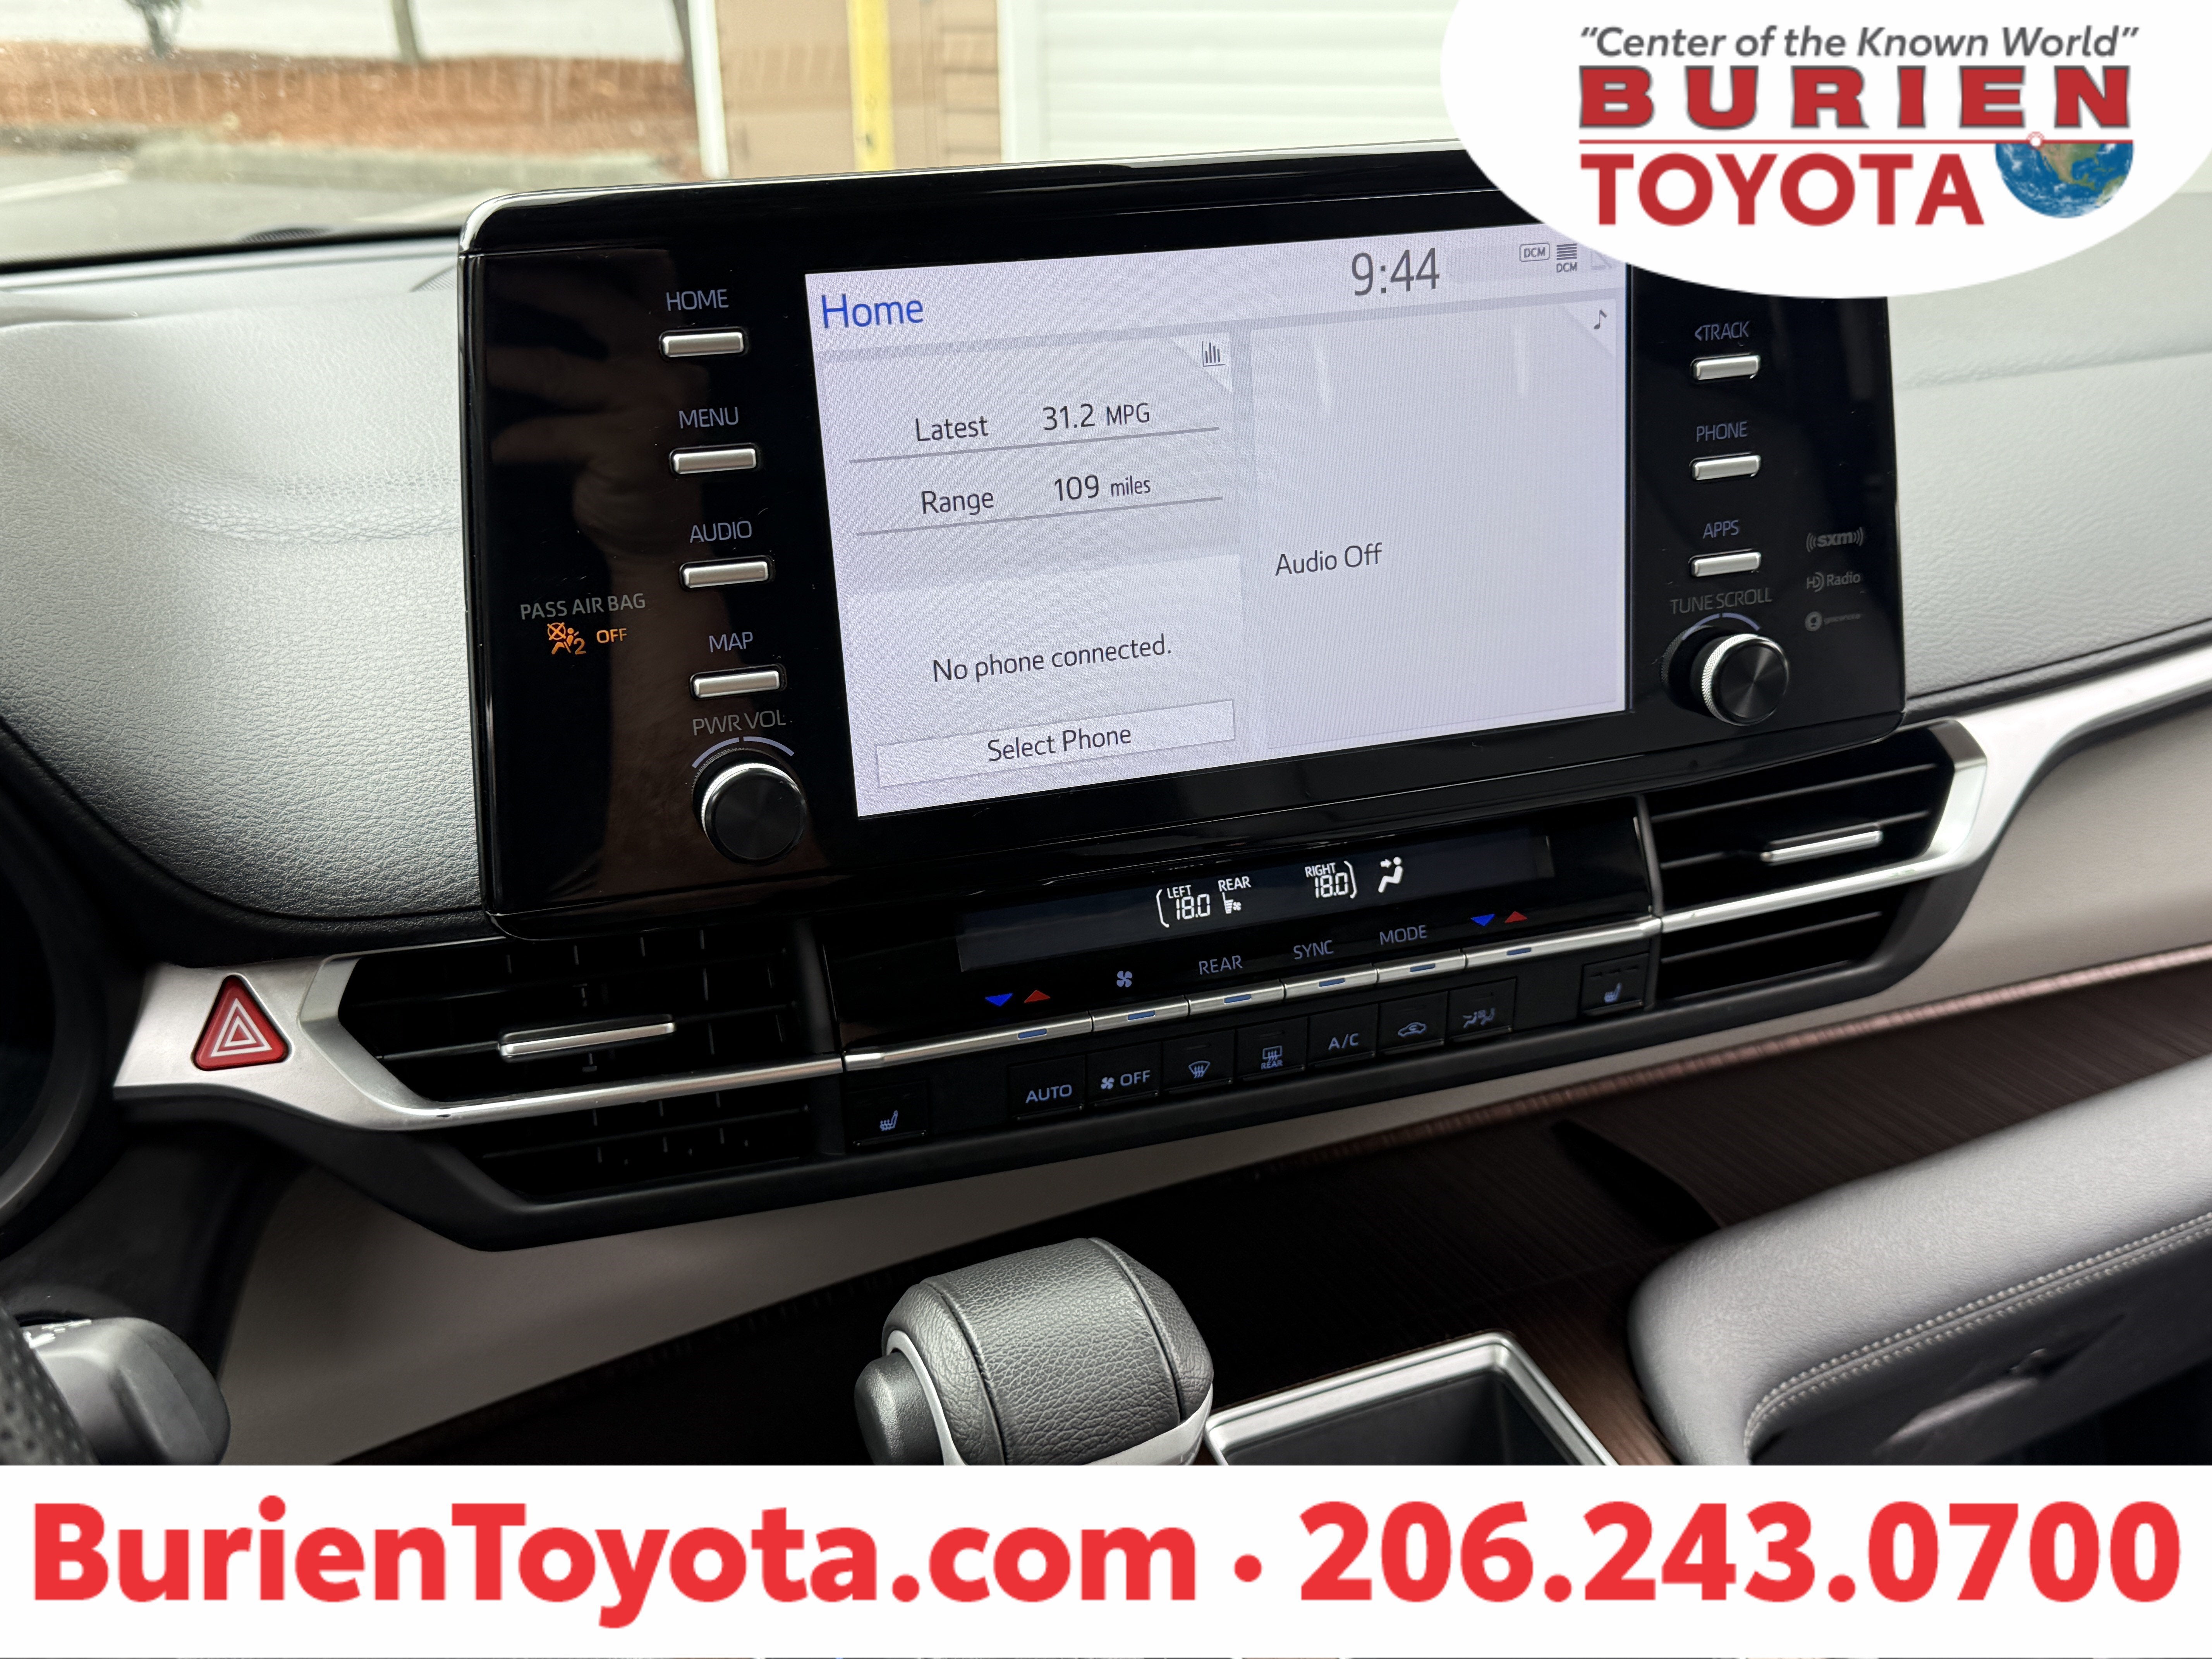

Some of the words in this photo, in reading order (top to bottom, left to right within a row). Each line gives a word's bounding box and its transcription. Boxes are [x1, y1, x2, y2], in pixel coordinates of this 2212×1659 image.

[1523, 247, 1546, 258] DCM
[1352, 247, 1440, 296] 9:44
[1556, 262, 1578, 273] DCM
[666, 289, 729, 311] HOME
[822, 294, 924, 328] Home
[679, 407, 739, 429] MENU
[915, 416, 989, 441] Latest
[1042, 403, 1095, 431] 31.2
[1106, 402, 1151, 426] MPG
[1696, 421, 1748, 442] PHONE
[921, 490, 994, 515] Range
[1054, 474, 1100, 501] 109
[1110, 476, 1151, 496] miles
[690, 520, 752, 543] AUDIO
[1703, 520, 1739, 539] APPS
[1275, 550, 1337, 576] Audio
[1345, 542, 1382, 567] Off
[1827, 571, 1860, 587] Radio
[520, 600, 568, 620] PASS
[572, 597, 605, 615] AIR
[608, 593, 646, 611] BAG
[1670, 596, 1712, 614] TUNE
[1716, 587, 1772, 609] SCROLL
[596, 628, 627, 643] OFF
[709, 632, 754, 653] MAP
[933, 659, 968, 682] No
[975, 652, 1044, 683] phone
[1052, 633, 1172, 668] connected.
[692, 714, 742, 736] PWR
[744, 709, 786, 730] VOL
[988, 734, 1055, 762] Select
[1062, 726, 1132, 752] Phone
[1304, 862, 1336, 878] RIGHT
[1167, 884, 1192, 899] LEFT
[1218, 876, 1251, 892] REAR
[1315, 872, 1349, 898] 18.0
[1176, 893, 1210, 921] 18.0
[1380, 925, 1427, 945] MODE
[1293, 939, 1334, 960] SYNC
[1199, 955, 1243, 975] REAR
[1328, 1033, 1359, 1051] A/C
[1261, 1059, 1283, 1070] REAR
[1120, 1070, 1151, 1087] OFF
[1025, 1084, 1072, 1104] AUTO
